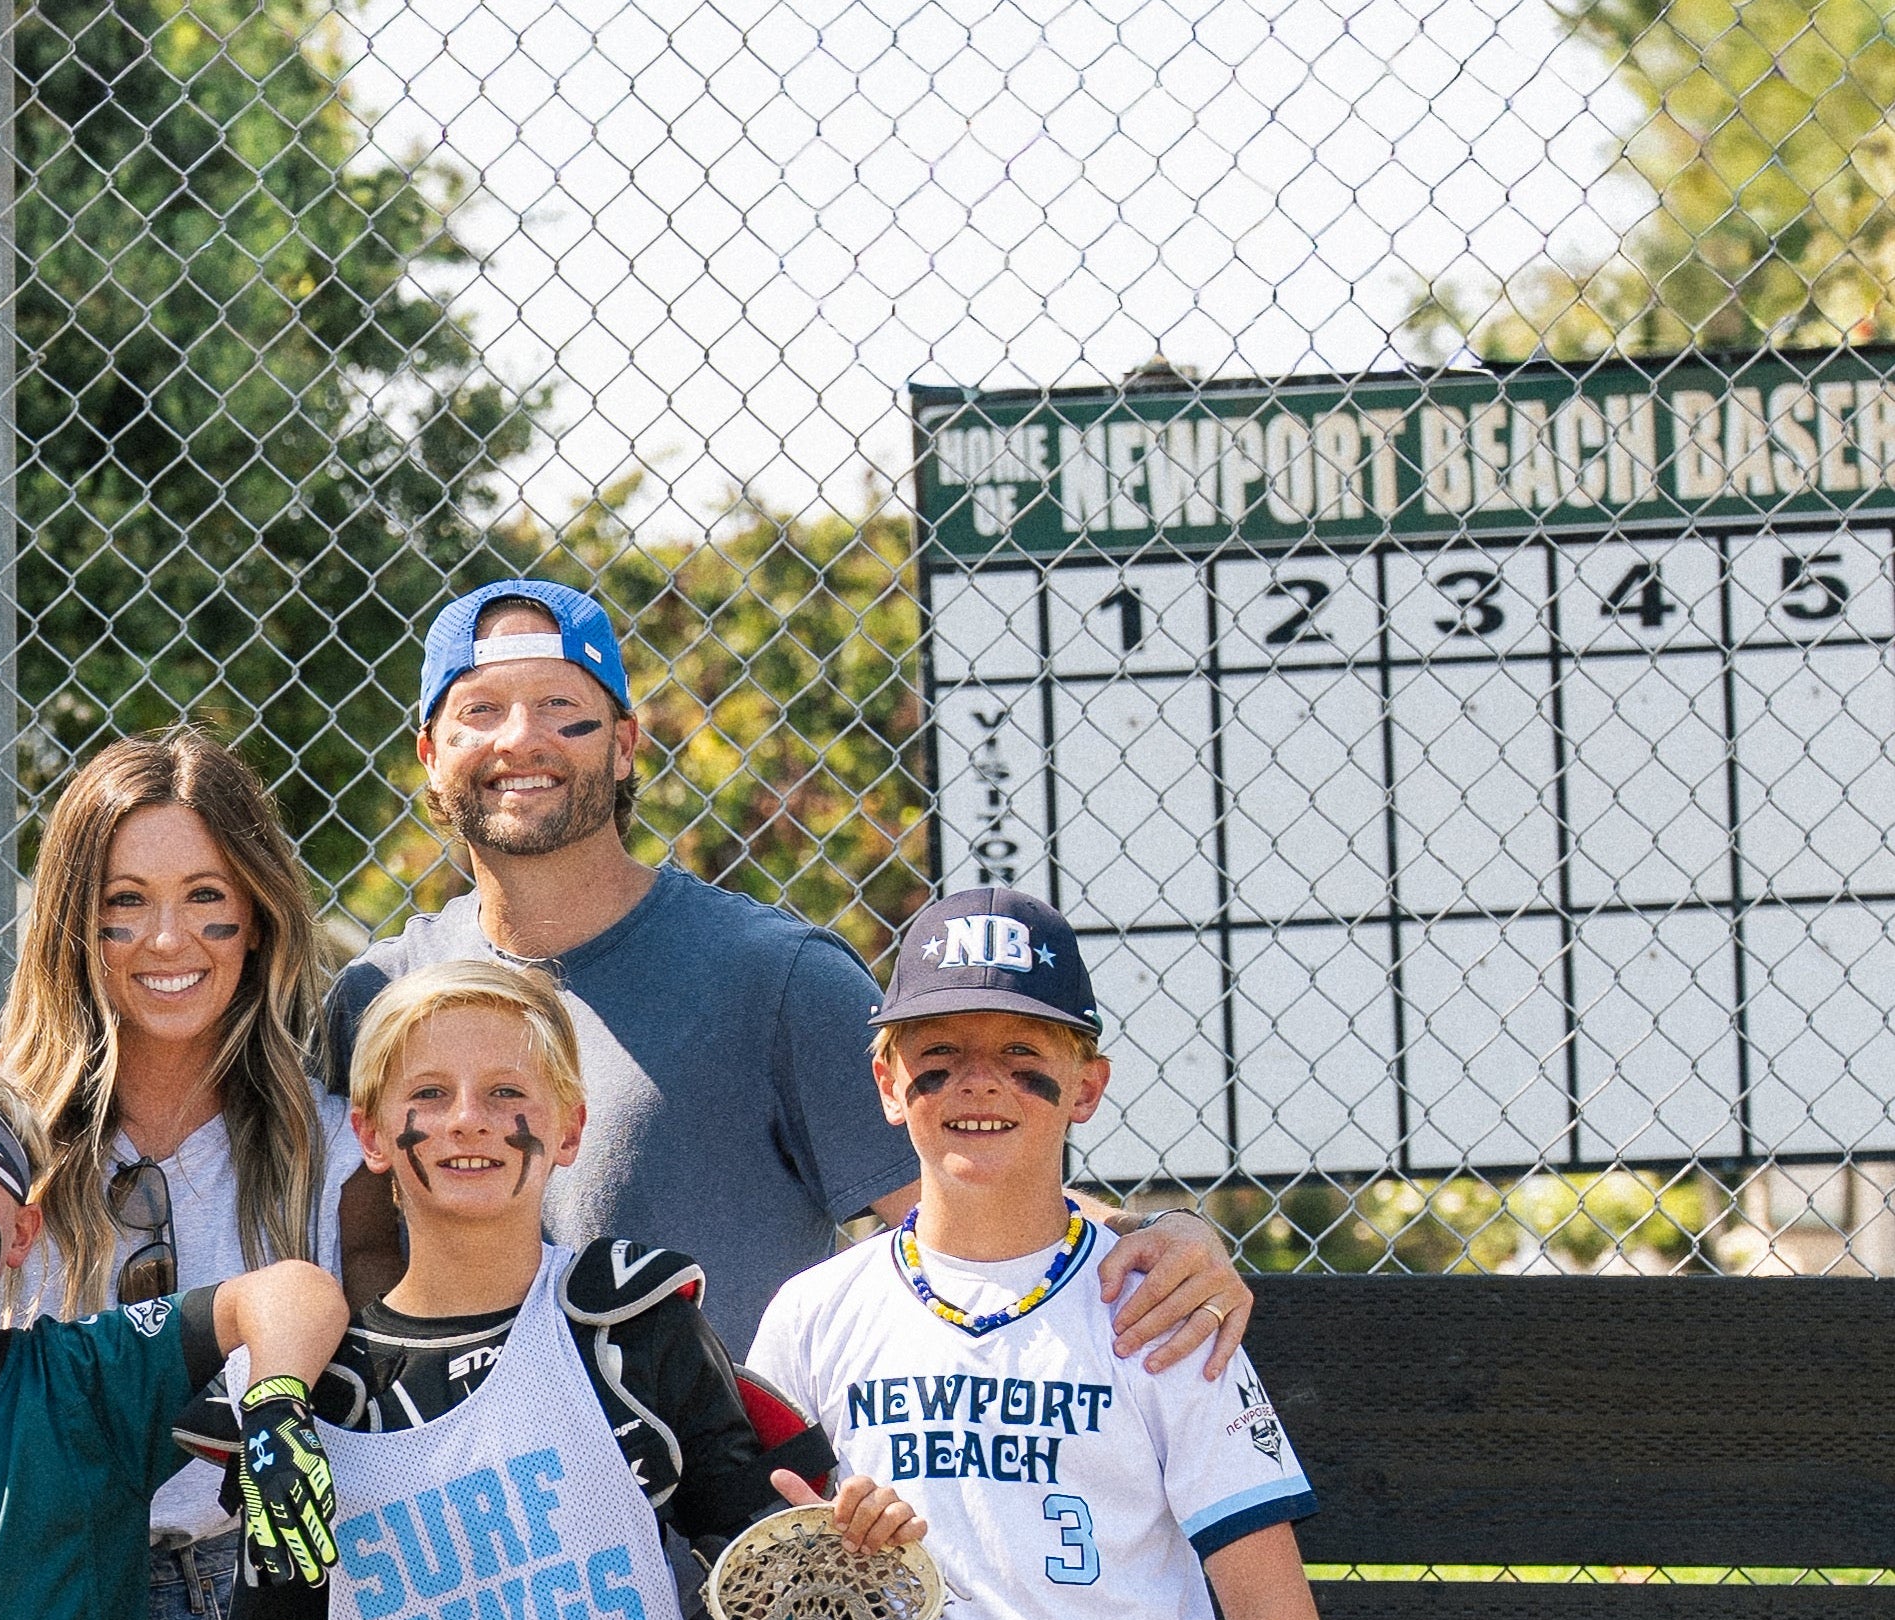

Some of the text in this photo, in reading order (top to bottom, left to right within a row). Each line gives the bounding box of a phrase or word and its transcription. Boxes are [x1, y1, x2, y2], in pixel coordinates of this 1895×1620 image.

[937, 423, 1048, 485] HOME
[1059, 405, 1403, 533] NEWPORT
[1419, 395, 1656, 516] BEACH
[972, 483, 1017, 537] OF
[1264, 577, 1335, 646] 2
[1433, 569, 1506, 637] 3
[1599, 562, 1677, 628] 4
[1782, 553, 1849, 620] 5
[1100, 587, 1146, 652] 1
[938, 913, 1033, 973] NB
[449, 1345, 504, 1381] STX
[847, 1374, 1113, 1436] NEWPORT
[889, 1429, 1063, 1485] BEACH
[1041, 1492, 1101, 1586] 3
